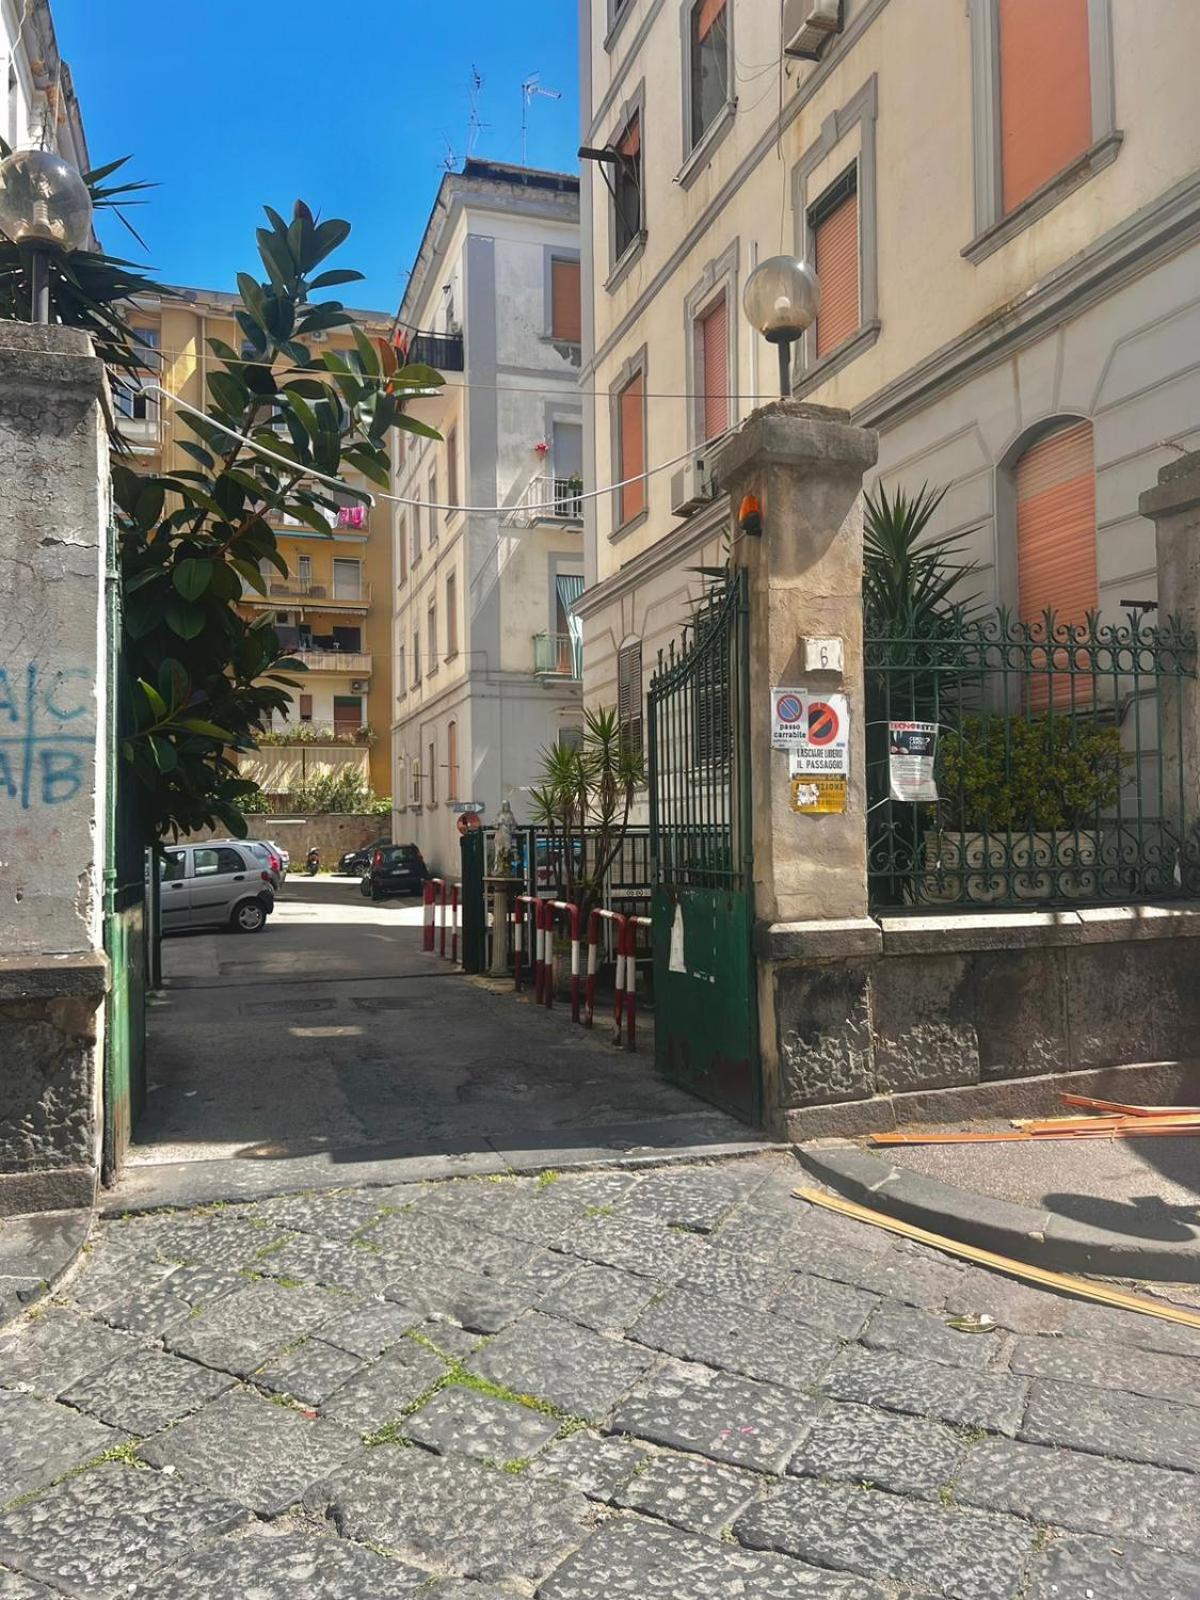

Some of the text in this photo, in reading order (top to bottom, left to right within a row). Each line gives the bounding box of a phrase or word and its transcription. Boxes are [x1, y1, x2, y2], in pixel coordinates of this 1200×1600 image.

[820, 646, 829, 669] 6
[779, 723, 801, 731] passo
[773, 731, 807, 739] carrabile
[797, 748, 843, 759] LASCIARE LIBERO
[797, 759, 844, 769] IL PASSAGGIO
